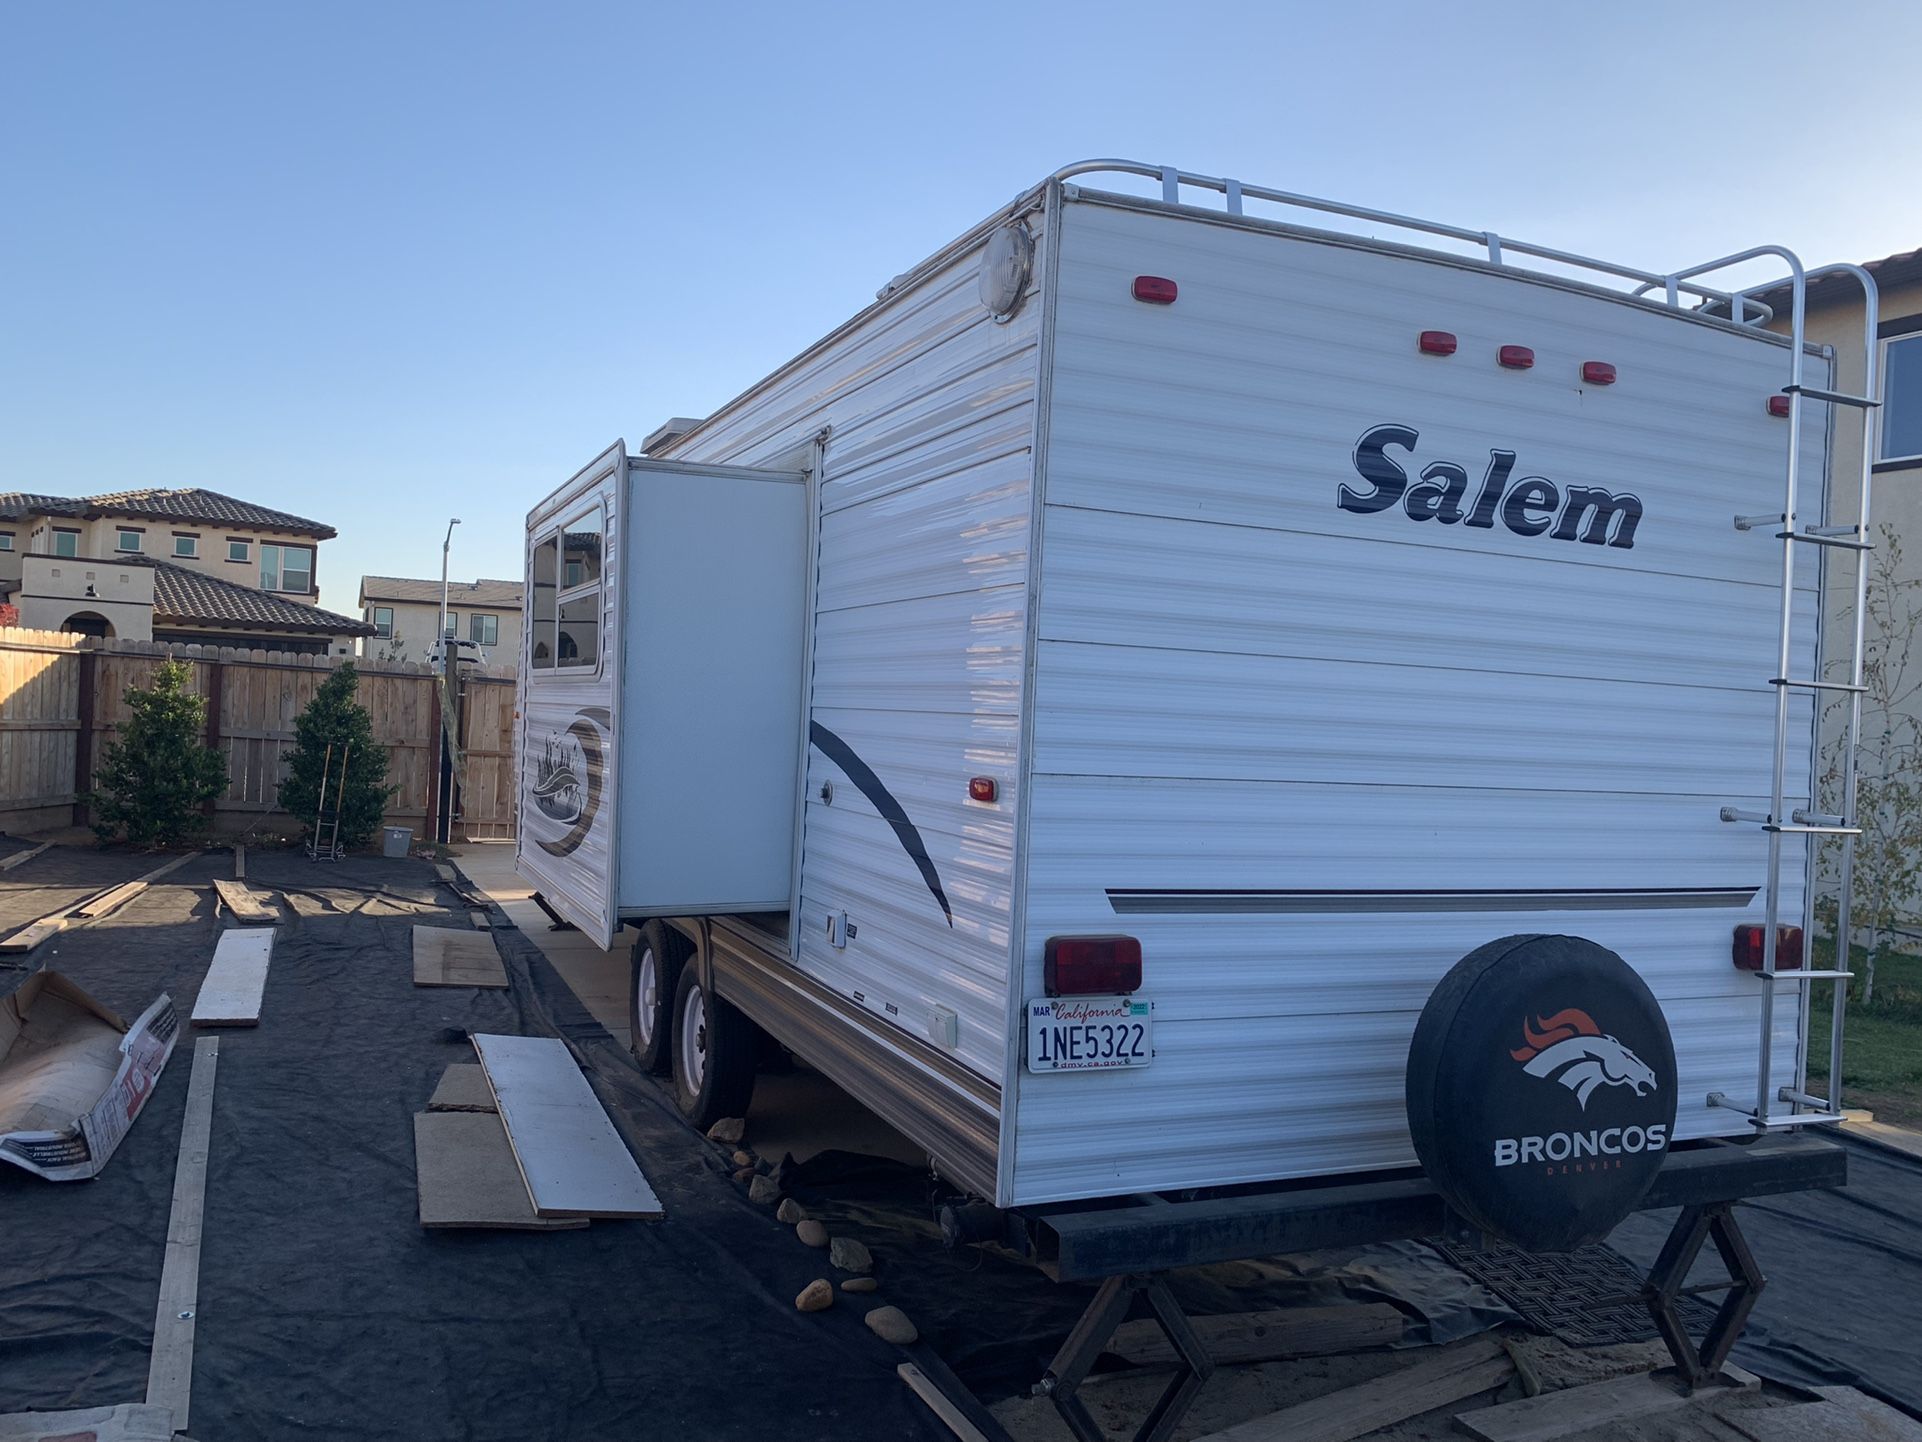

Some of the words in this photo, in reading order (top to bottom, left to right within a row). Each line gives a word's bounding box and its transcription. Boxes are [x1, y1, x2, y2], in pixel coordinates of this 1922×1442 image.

[1337, 423, 1643, 549] Salem
[1033, 1006, 1050, 1016] MAR
[1055, 1003, 1130, 1024] California
[1038, 1023, 1144, 1062] 1NE5322
[1060, 1059, 1123, 1069] dmv.ca.gov
[1494, 1124, 1666, 1167] BRONCOS
[1547, 1159, 1622, 1176] DENVER
